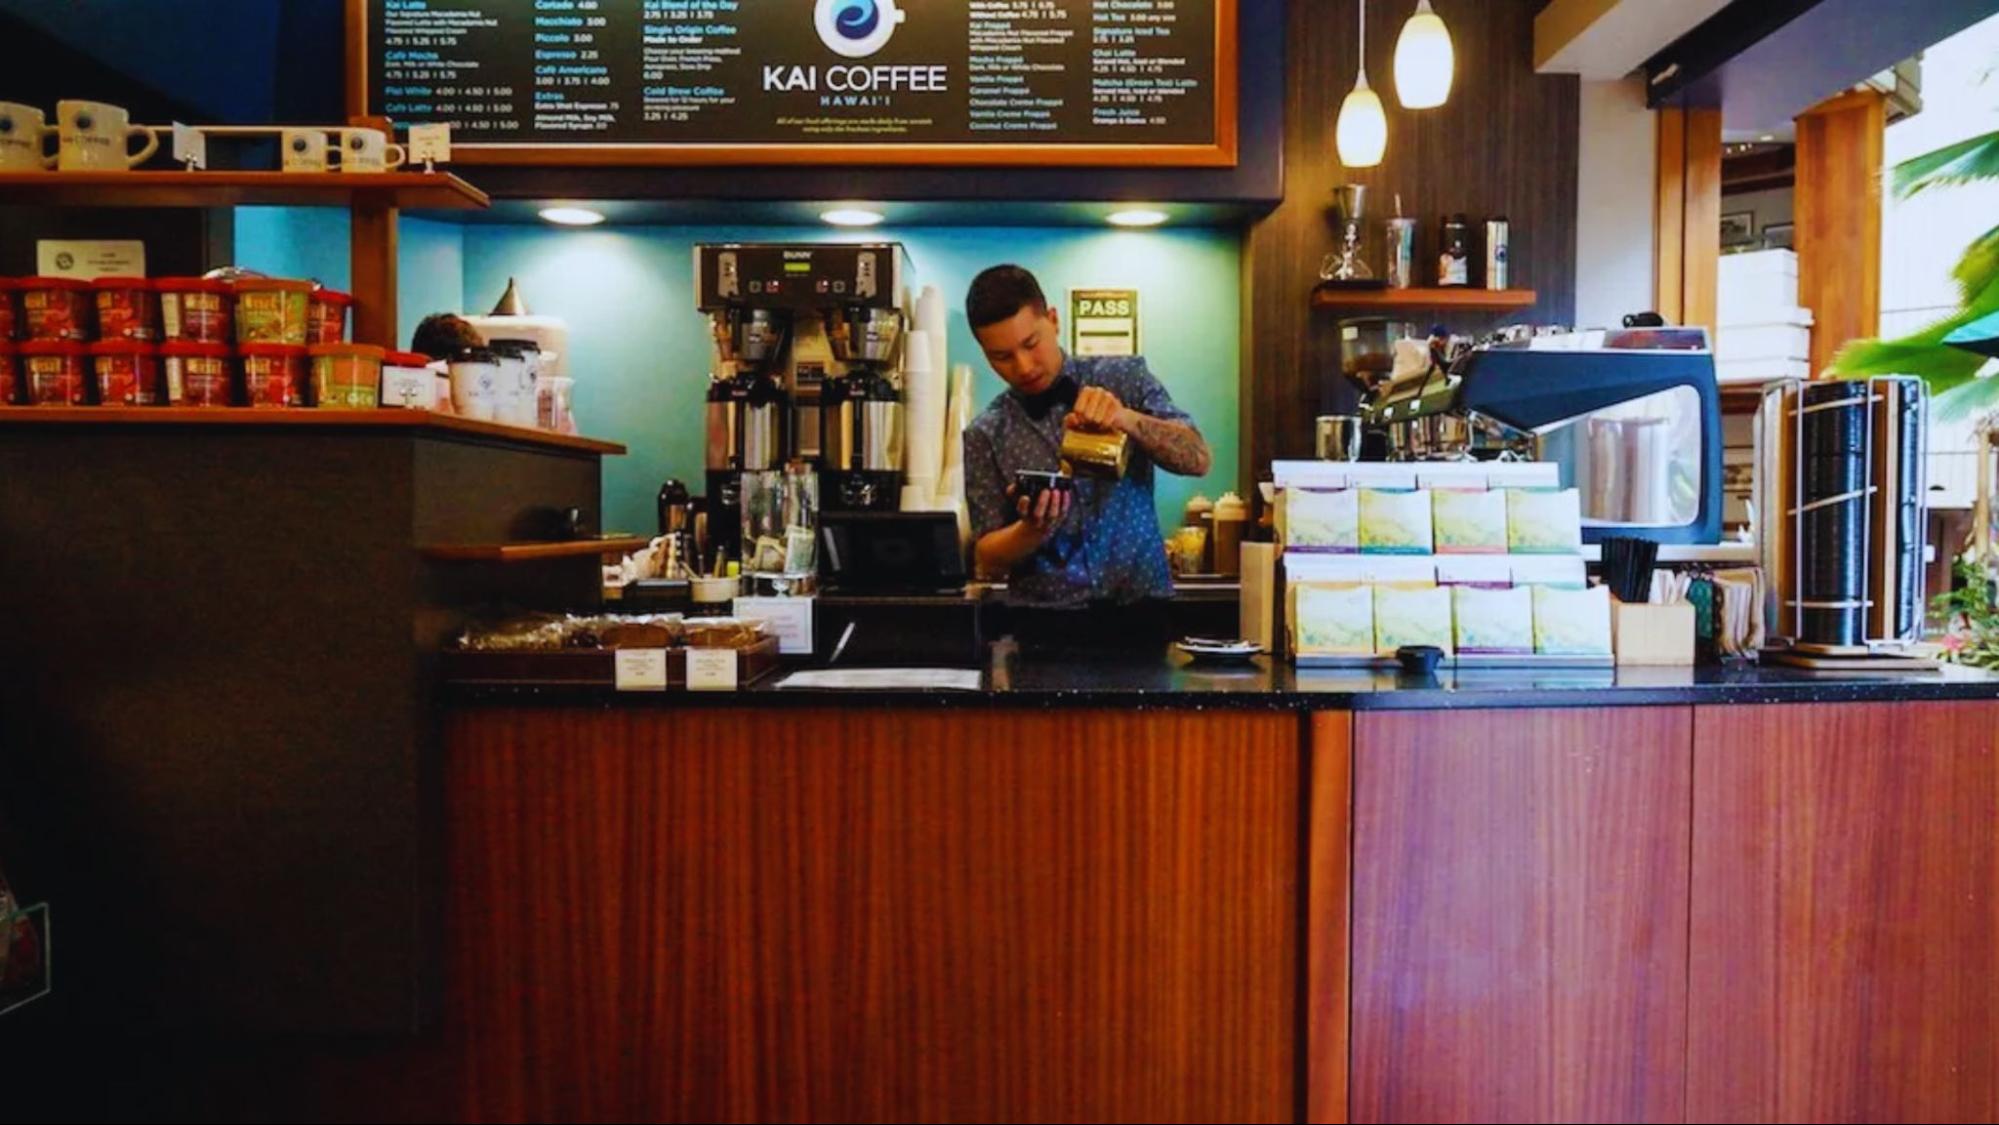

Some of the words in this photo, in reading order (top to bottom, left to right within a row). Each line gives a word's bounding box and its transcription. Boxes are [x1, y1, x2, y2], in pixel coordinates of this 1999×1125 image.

[535, 0, 574, 11] Cortado
[578, 0, 598, 11] 4.00
[644, 1, 661, 11] Kai
[661, 1, 689, 11] Blend
[701, 1, 719, 11] the
[719, 1, 738, 11] Day
[645, 26, 674, 36] Single
[675, 26, 704, 36] Origin
[706, 26, 737, 36] Coffee
[535, 50, 577, 61] Espresso
[581, 50, 599, 61] 2.25
[763, 65, 816, 91] KAI
[825, 65, 947, 91] COFFEE
[385, 87, 404, 97] Flat
[405, 87, 432, 97] White
[436, 87, 456, 97] 4.00
[465, 87, 485, 97] 4.50
[494, 87, 513, 97] 5.00
[535, 92, 565, 102] Extras
[644, 87, 667, 97] Cold
[668, 87, 692, 97] Brew
[693, 87, 725, 97] Coffee
[820, 96, 890, 106] HAWAI'I
[783, 251, 813, 260] BUNN
[1080, 300, 1130, 316] PASS
